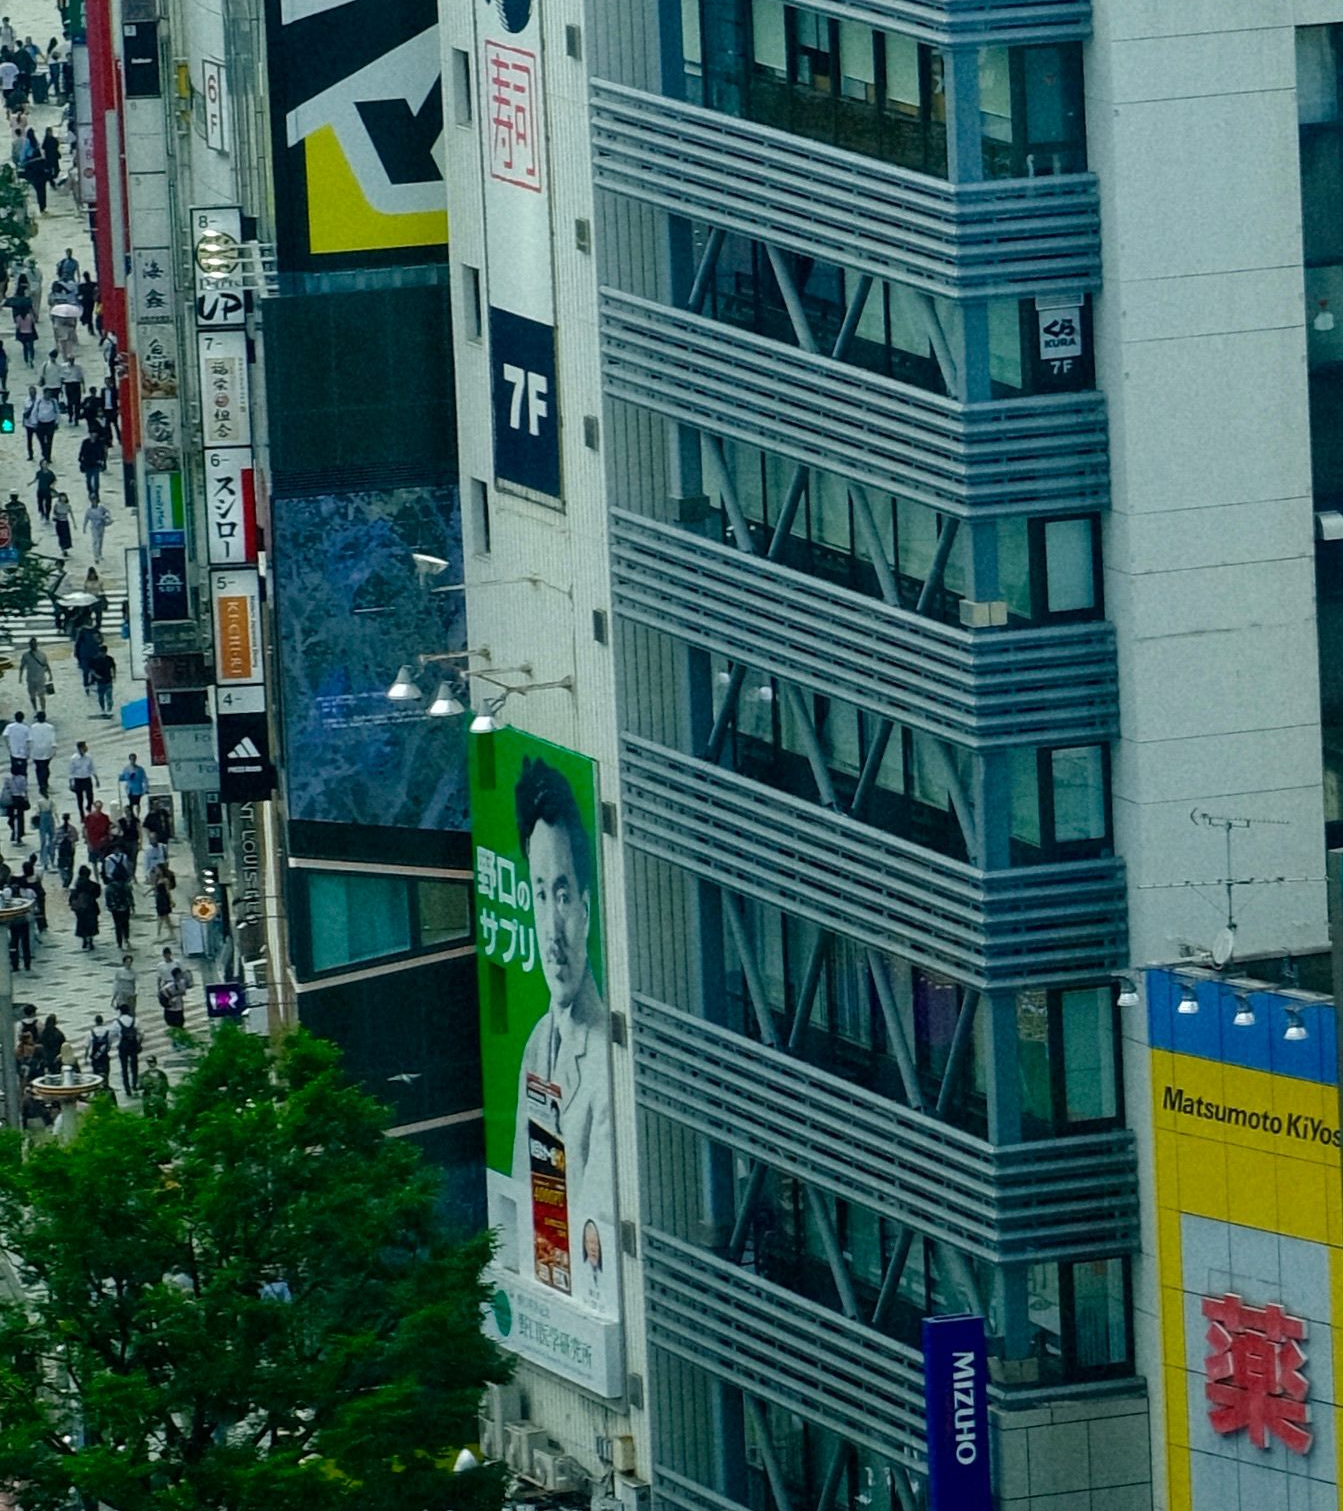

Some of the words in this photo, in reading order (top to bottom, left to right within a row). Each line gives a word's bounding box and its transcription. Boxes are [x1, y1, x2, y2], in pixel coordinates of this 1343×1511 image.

[199, 293, 242, 321] UP
[502, 364, 549, 435] 7F
[213, 476, 238, 557] スシロー
[476, 845, 531, 912] 野口の
[480, 907, 535, 973] サプリ
[1162, 1087, 1283, 1135] Matsumoto
[1287, 1112, 1341, 1147] KiYos
[1201, 1291, 1314, 1456] 薬
[952, 1351, 976, 1467] MIZUHO
